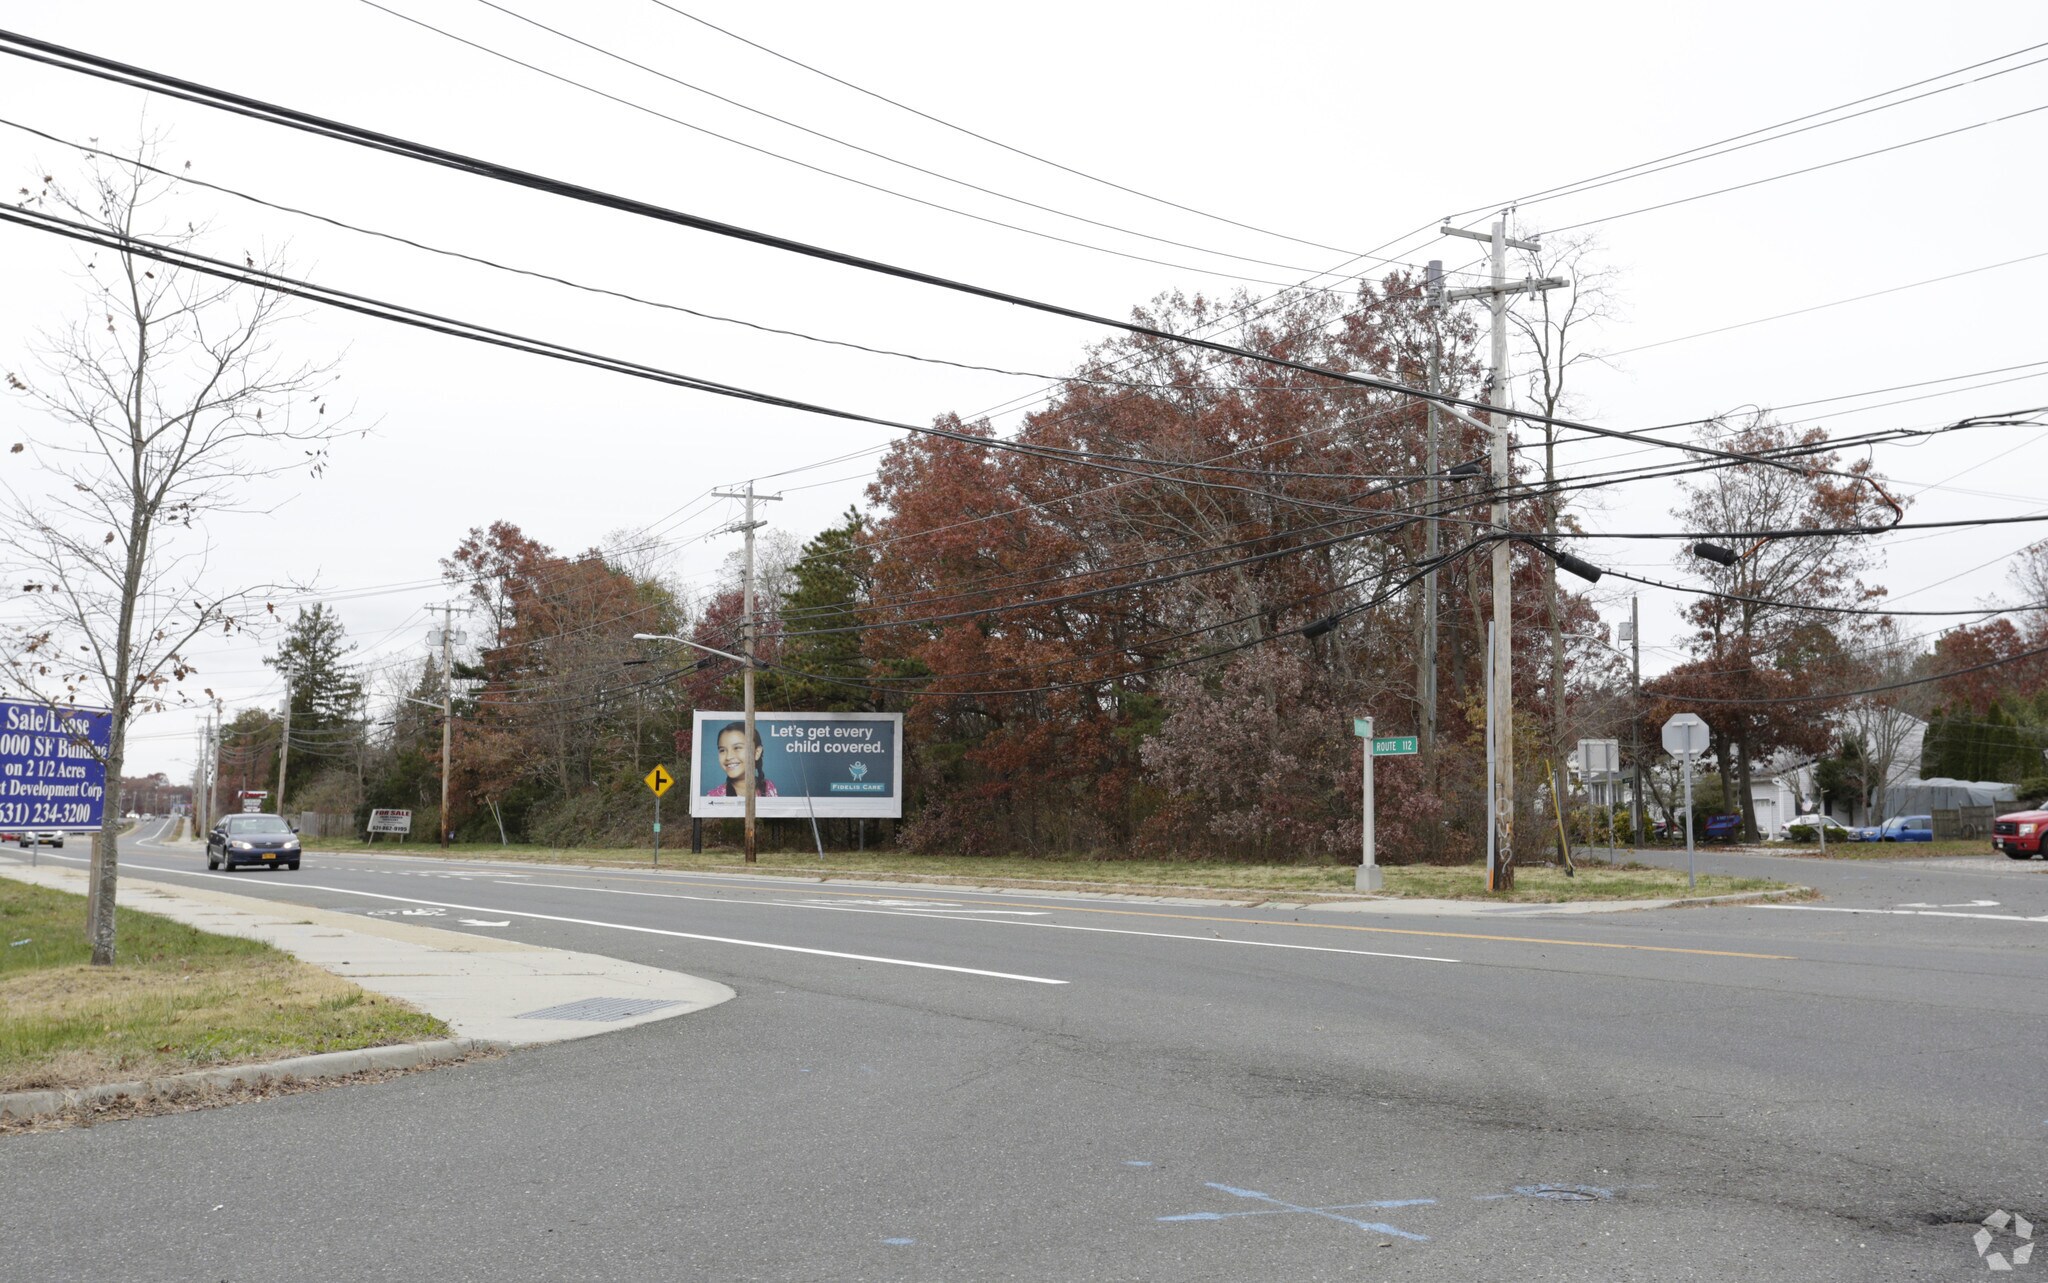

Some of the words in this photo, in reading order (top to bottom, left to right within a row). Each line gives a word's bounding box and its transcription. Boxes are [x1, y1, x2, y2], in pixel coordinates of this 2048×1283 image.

[7, 706, 90, 735] Sale/Lease
[808, 726, 830, 740] get
[834, 728, 873, 740] every
[34, 736, 55, 757] SF
[786, 741, 820, 753] child
[824, 741, 885, 753] covered.
[1376, 741, 1397, 752] ROUTE
[1402, 740, 1413, 751] 112
[5, 763, 22, 776] on
[26, 760, 34, 776] 2
[38, 761, 55, 777] 1/2
[57, 763, 86, 778] Acres
[9, 779, 79, 801] Development
[80, 782, 103, 801] Corp
[32, 803, 91, 823] 234-3200
